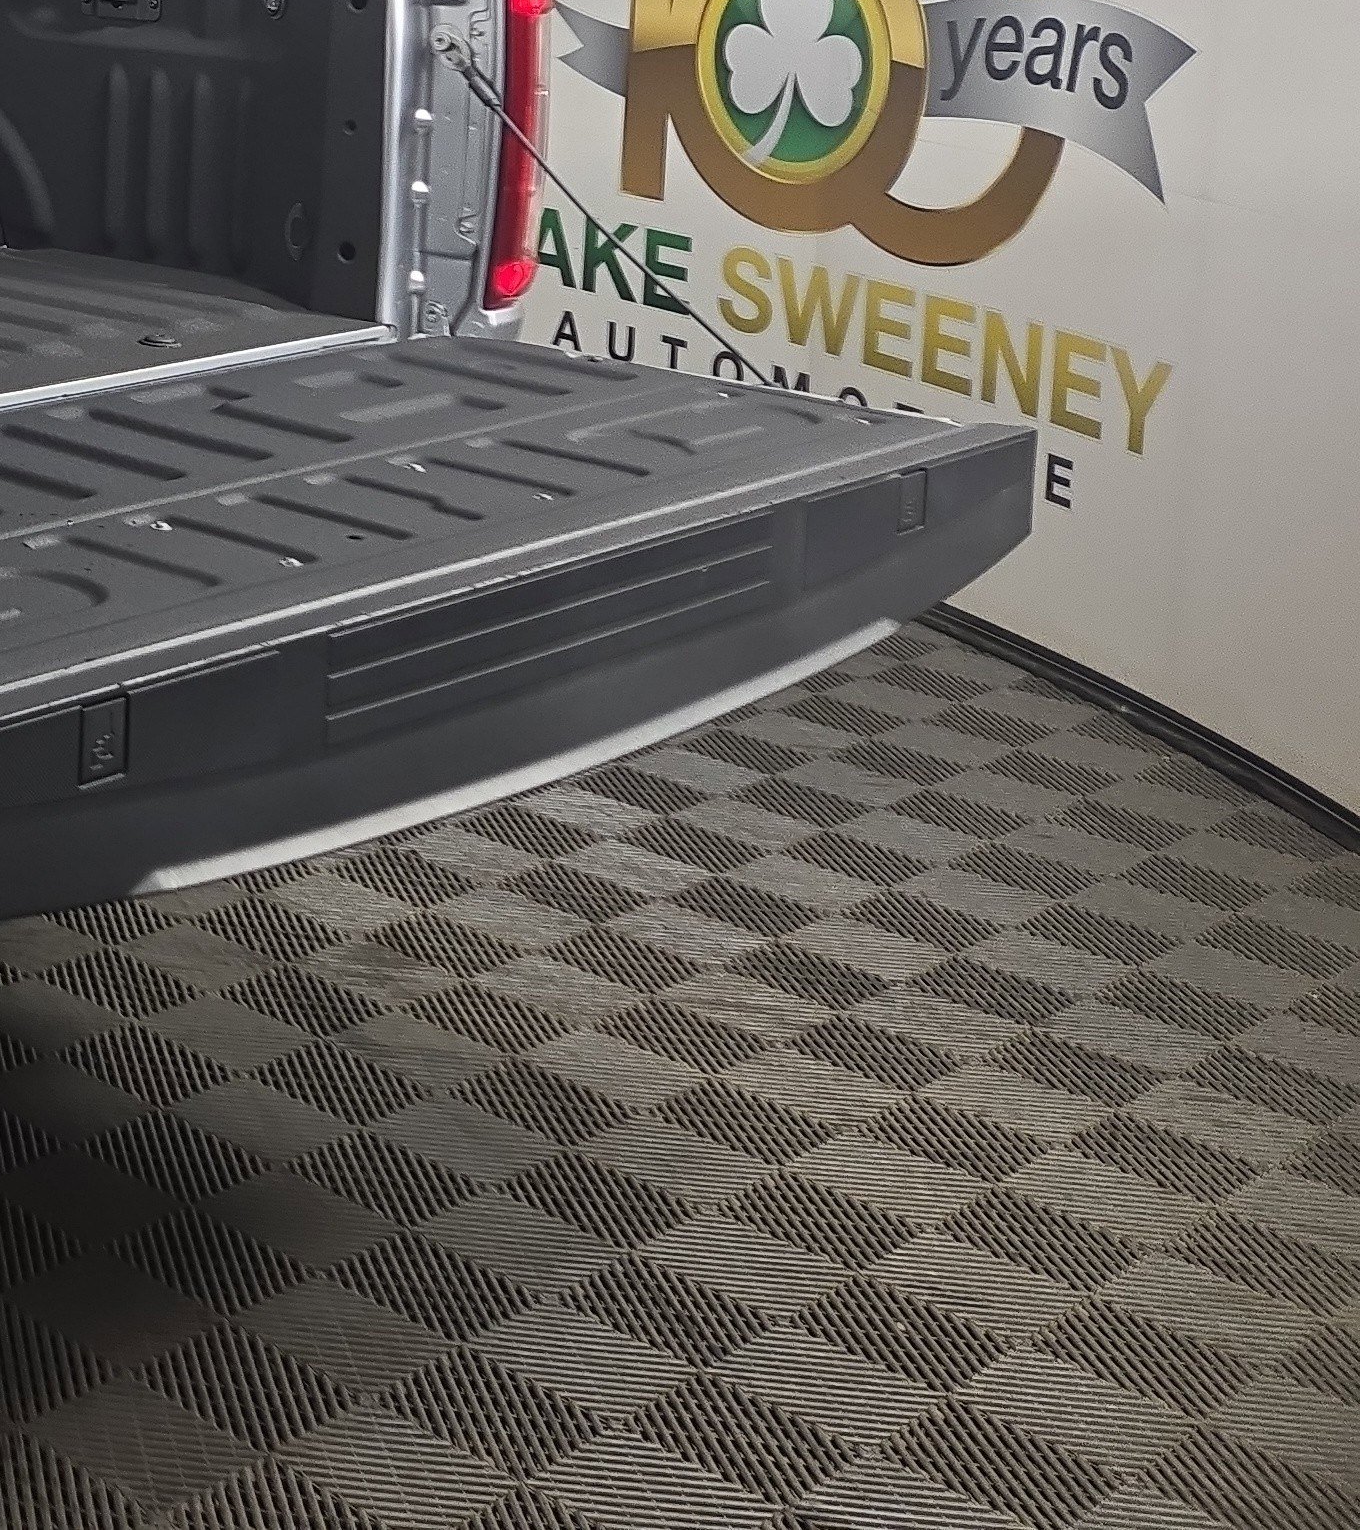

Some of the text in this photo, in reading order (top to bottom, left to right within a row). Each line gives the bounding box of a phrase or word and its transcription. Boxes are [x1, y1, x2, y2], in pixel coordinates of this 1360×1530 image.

[940, 15, 1133, 110] years
[537, 207, 1173, 454] AKE SWEENEY
[551, 310, 1074, 510] AUTOE
